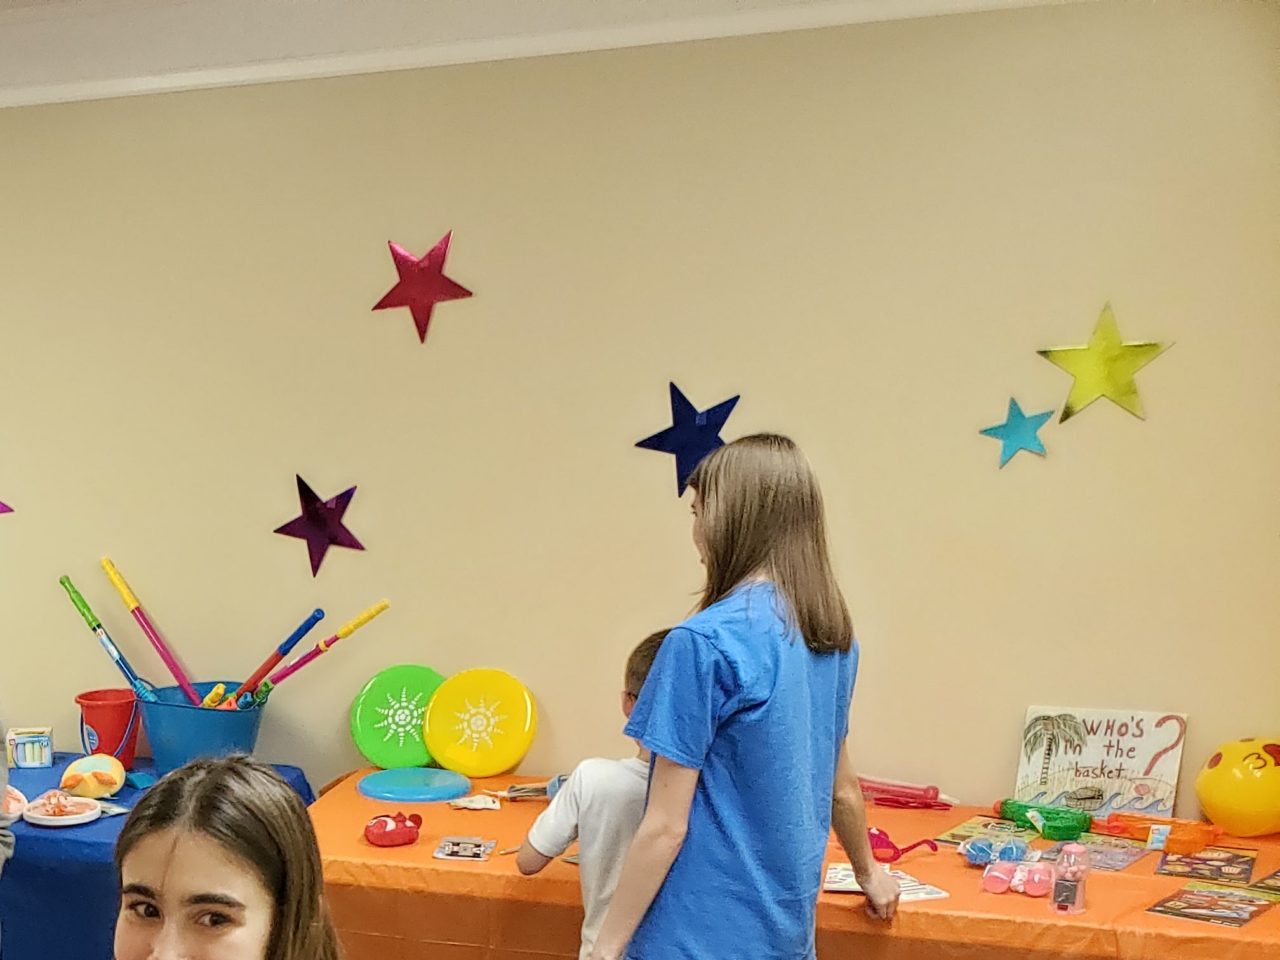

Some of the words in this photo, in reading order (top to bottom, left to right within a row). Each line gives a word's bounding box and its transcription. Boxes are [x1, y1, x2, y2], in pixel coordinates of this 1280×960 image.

[1082, 715, 1145, 739] WHO'S
[1064, 737, 1083, 756] in
[1103, 738, 1136, 759] the
[1074, 759, 1126, 781] basket
